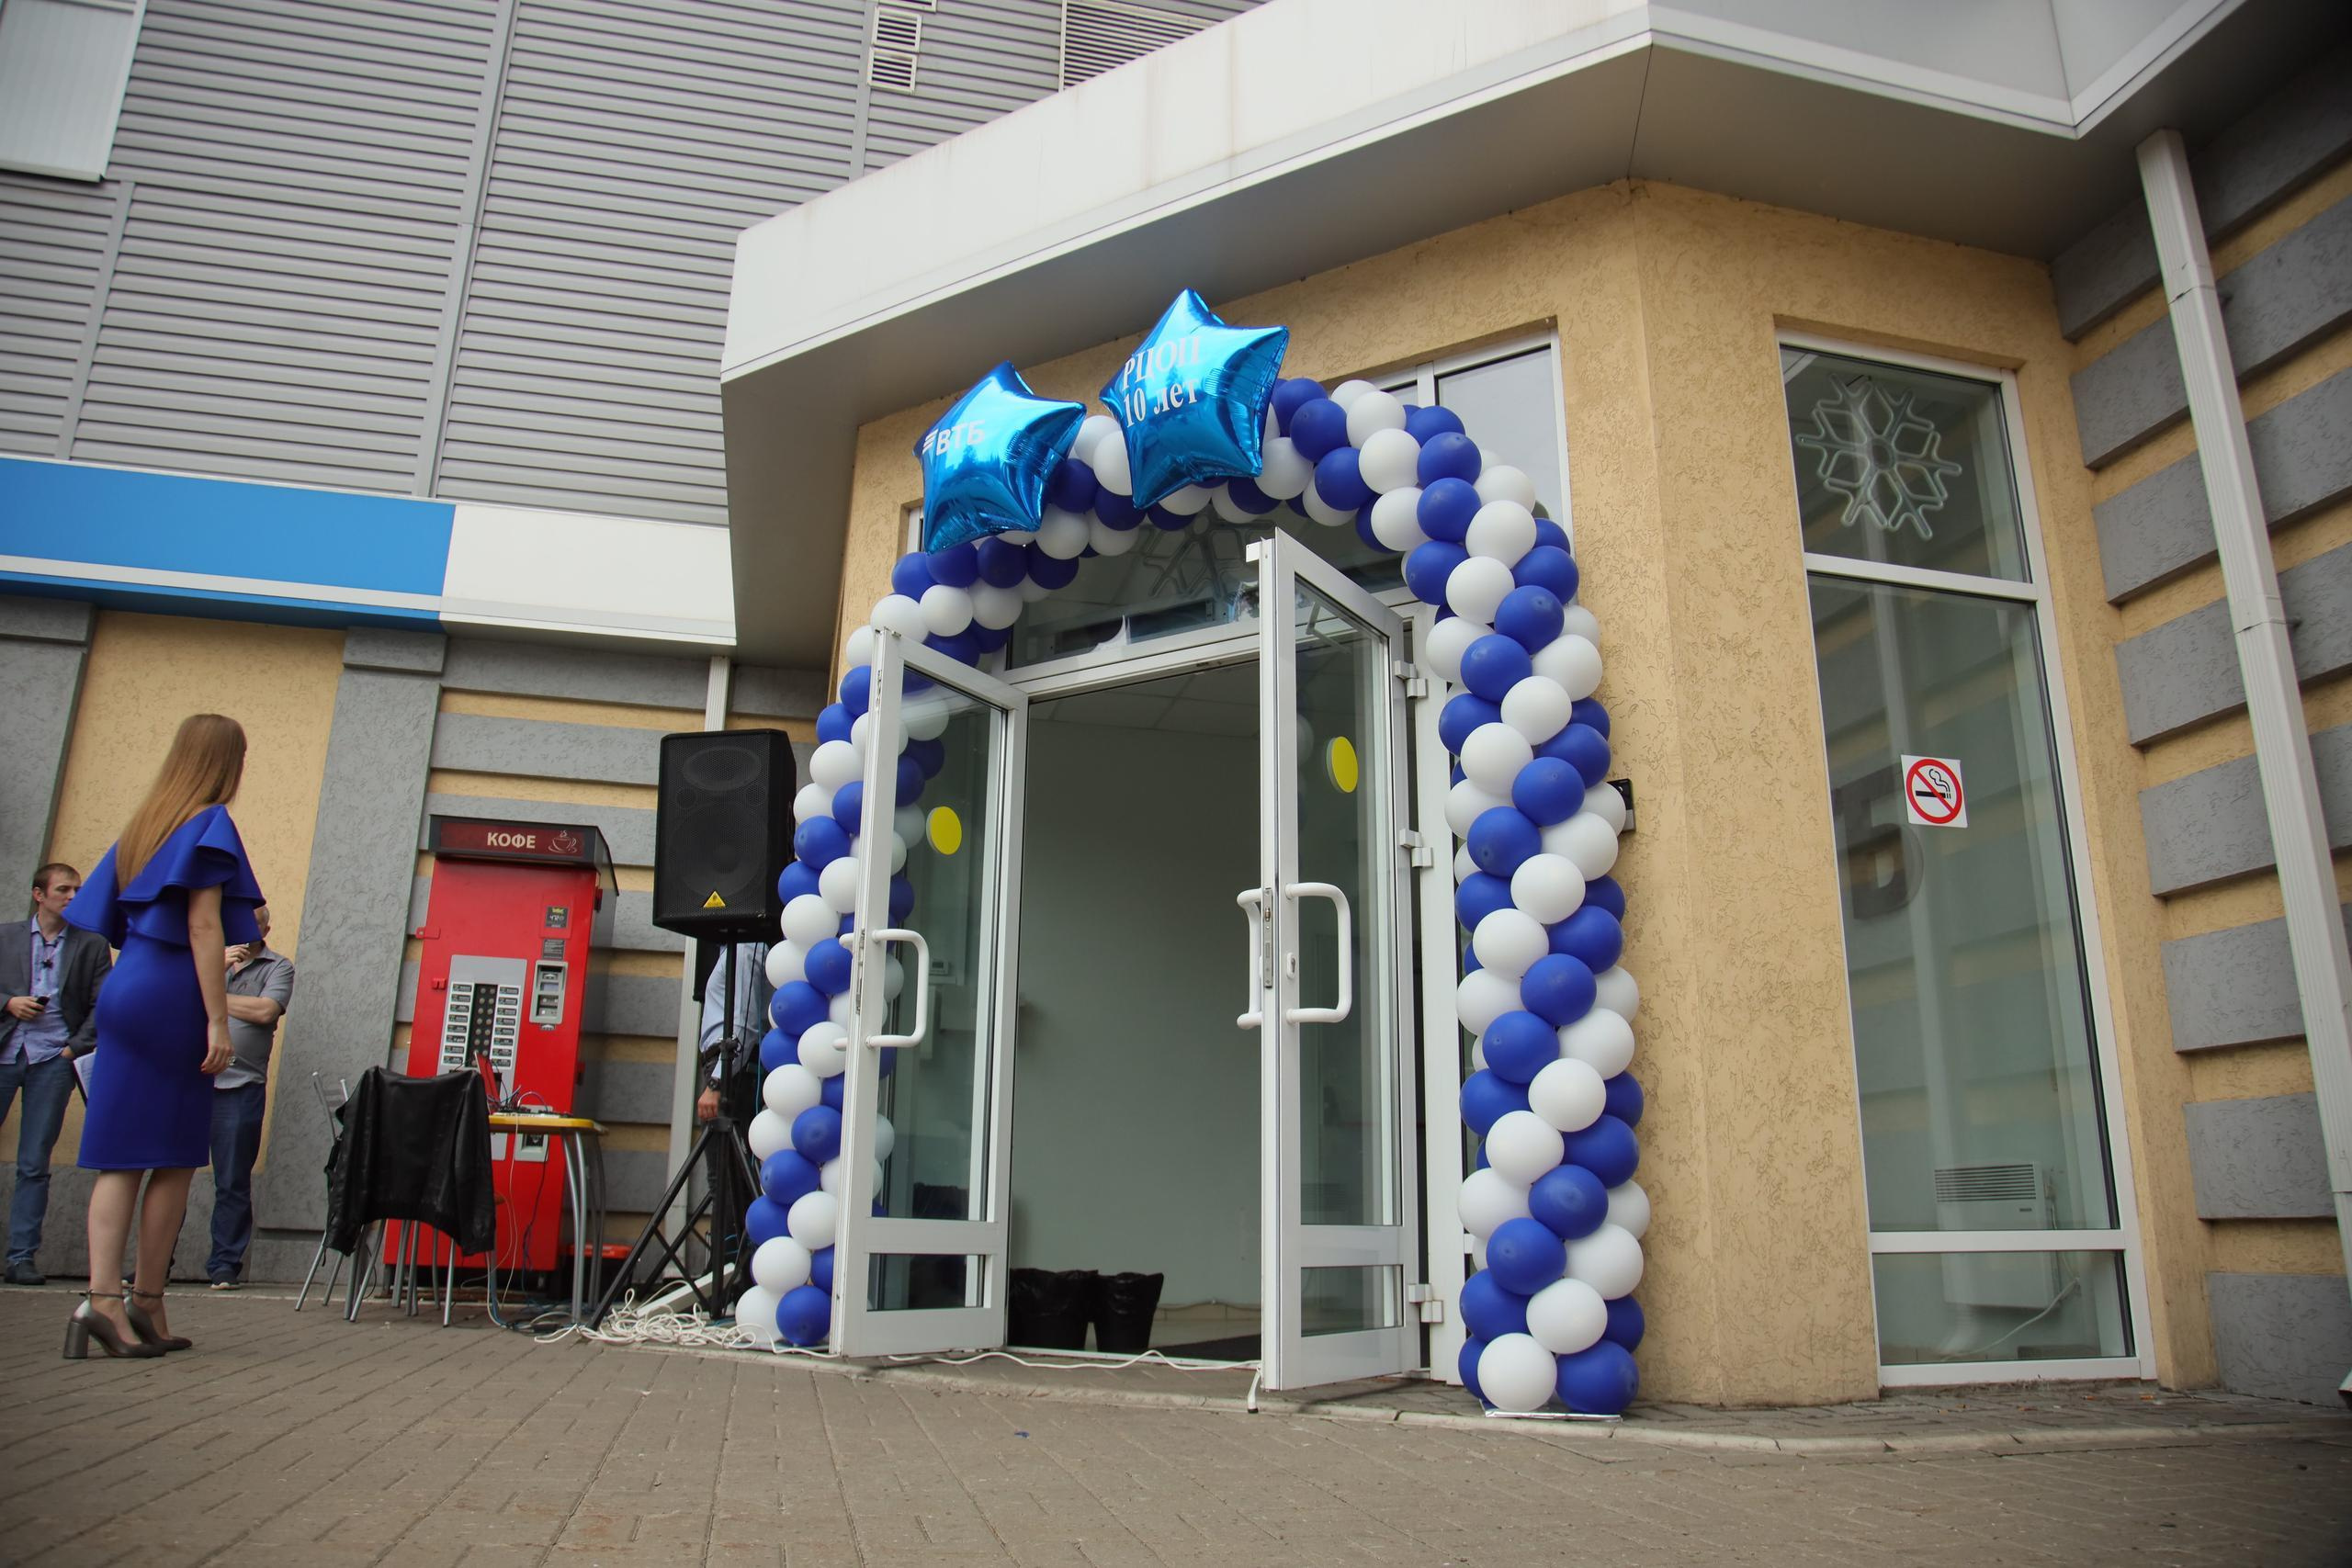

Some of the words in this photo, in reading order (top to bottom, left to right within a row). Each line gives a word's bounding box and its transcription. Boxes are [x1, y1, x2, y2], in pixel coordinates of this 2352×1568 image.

[1122, 336, 1201, 390] РЦОП
[1124, 388, 1146, 428] 10
[1154, 379, 1201, 416] лет
[936, 420, 986, 457] ВТБ
[487, 831, 537, 850] КОФЕ
